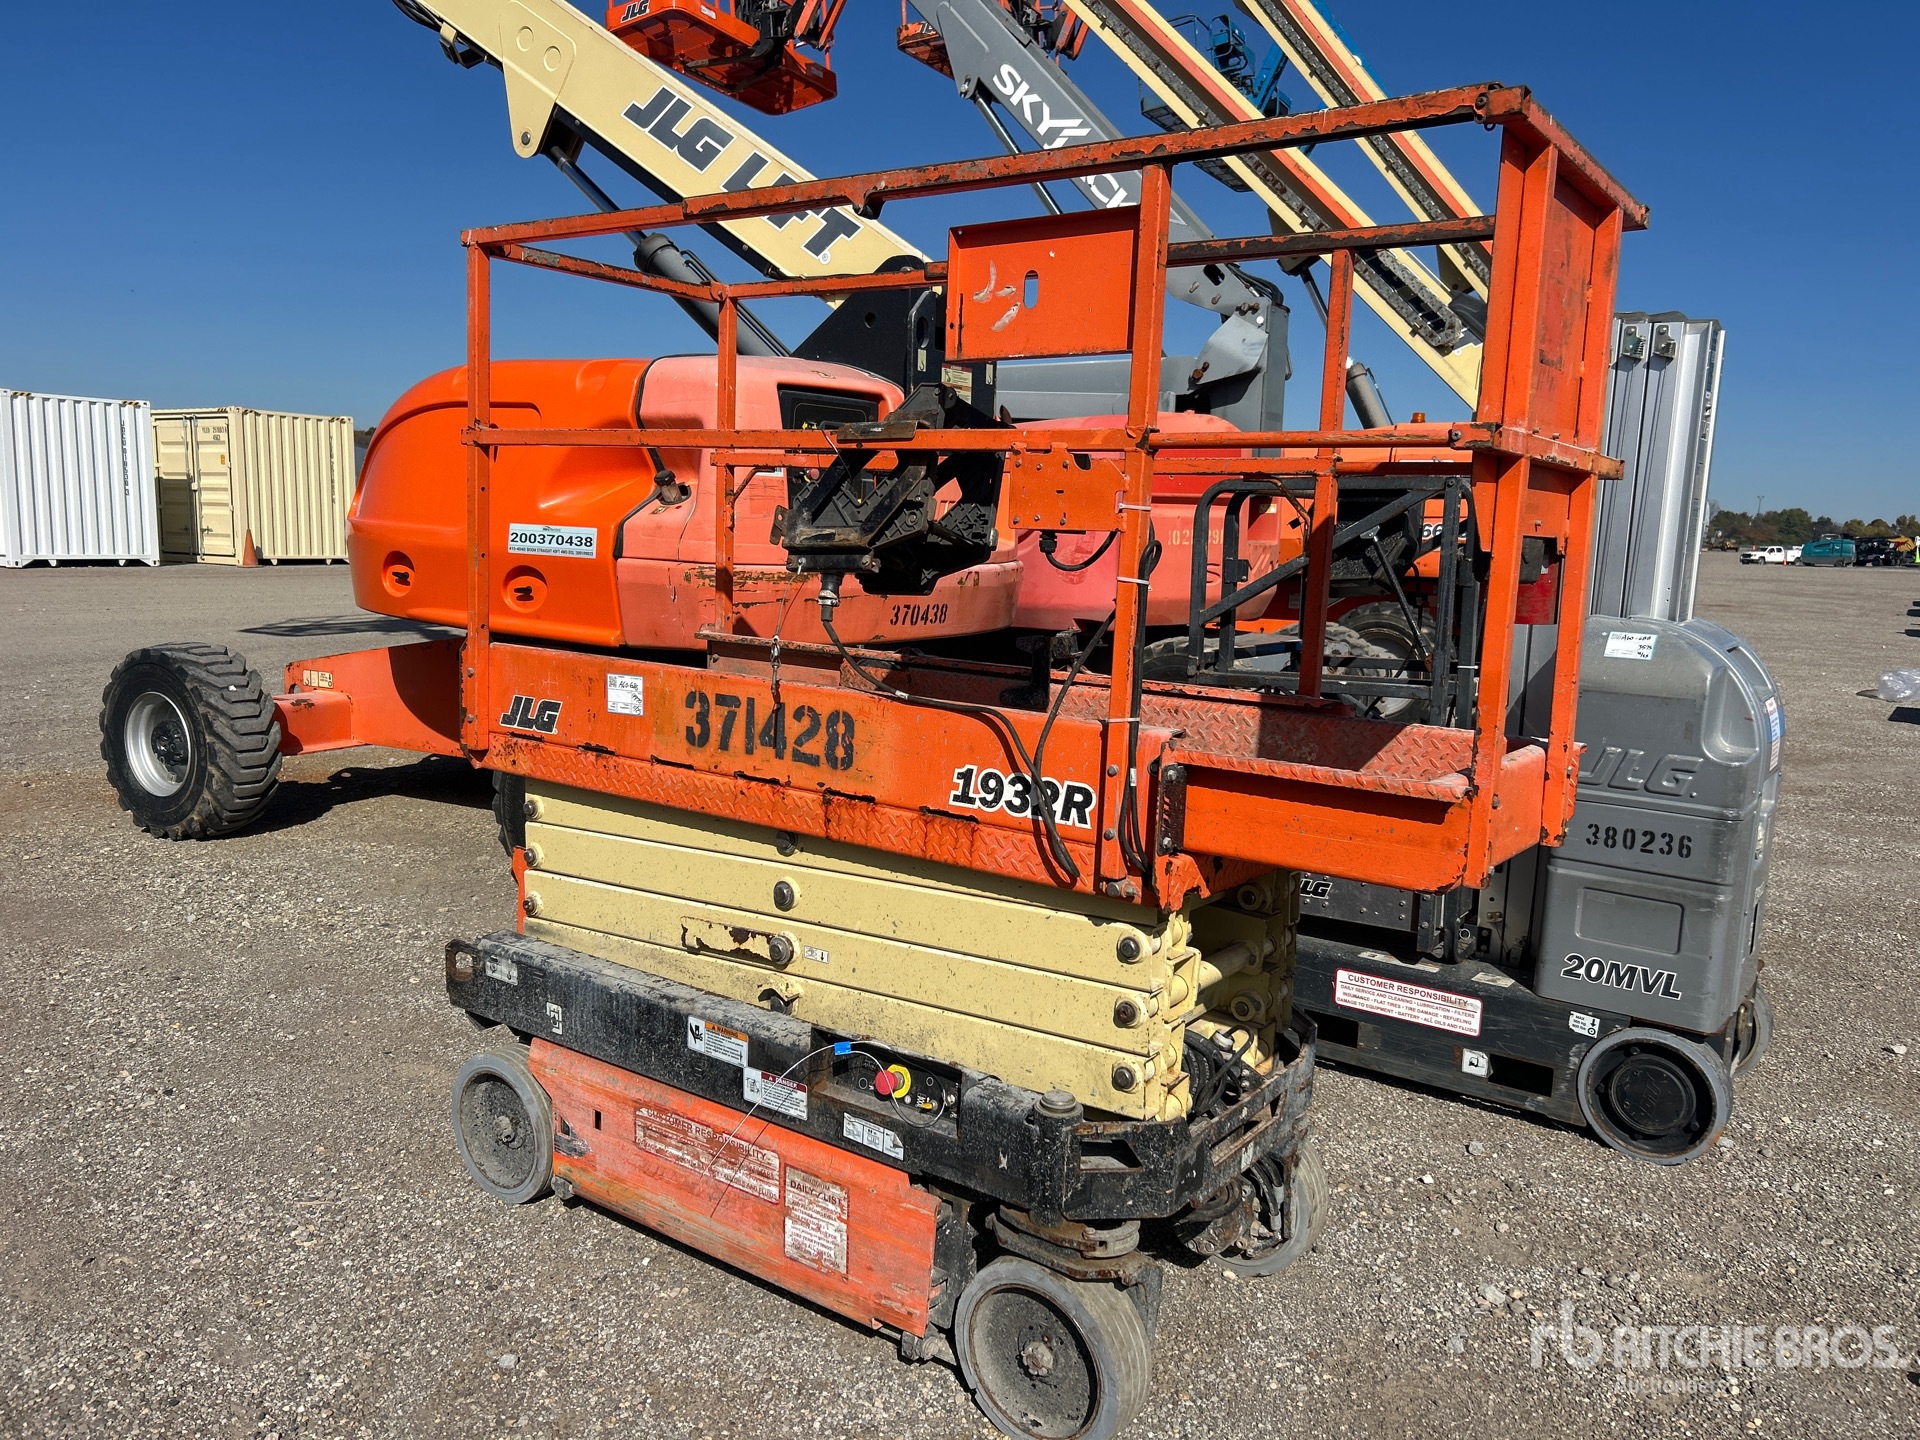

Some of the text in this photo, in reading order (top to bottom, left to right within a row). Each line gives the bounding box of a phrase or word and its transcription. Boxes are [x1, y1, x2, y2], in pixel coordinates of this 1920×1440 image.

[621, 0, 650, 23] JLG
[621, 84, 737, 174] JLG
[510, 532, 593, 547] 200370438
[890, 603, 949, 626] 370438
[500, 694, 562, 734] JLG
[685, 690, 856, 770] 371428
[1578, 746, 1703, 797] JLG
[1585, 823, 1693, 859] 380236
[1300, 878, 1333, 899] LG
[1347, 974, 1468, 1007] CUSTOMER RESPONSIBILITY
[1560, 952, 1682, 1001] 20MVL
[1337, 996, 1356, 1005] DAMAGE
[1365, 1003, 1393, 1014] EQUIPMENT
[1397, 1010, 1419, 1020] BATTERY
[1458, 1025, 1477, 1033] FLUIDS
[1342, 991, 1369, 1001] INSURANCE
[1416, 1008, 1438, 1017] DAMAGE
[1442, 1014, 1471, 1025] REFUELING
[1355, 987, 1375, 996] SERVICE
[1387, 994, 1412, 1004] CLEANING
[1416, 1001, 1450, 1013] LUBRICATION
[1453, 1009, 1474, 1018] FILTERS
[790, 1179, 841, 1207] DAILY LIST
